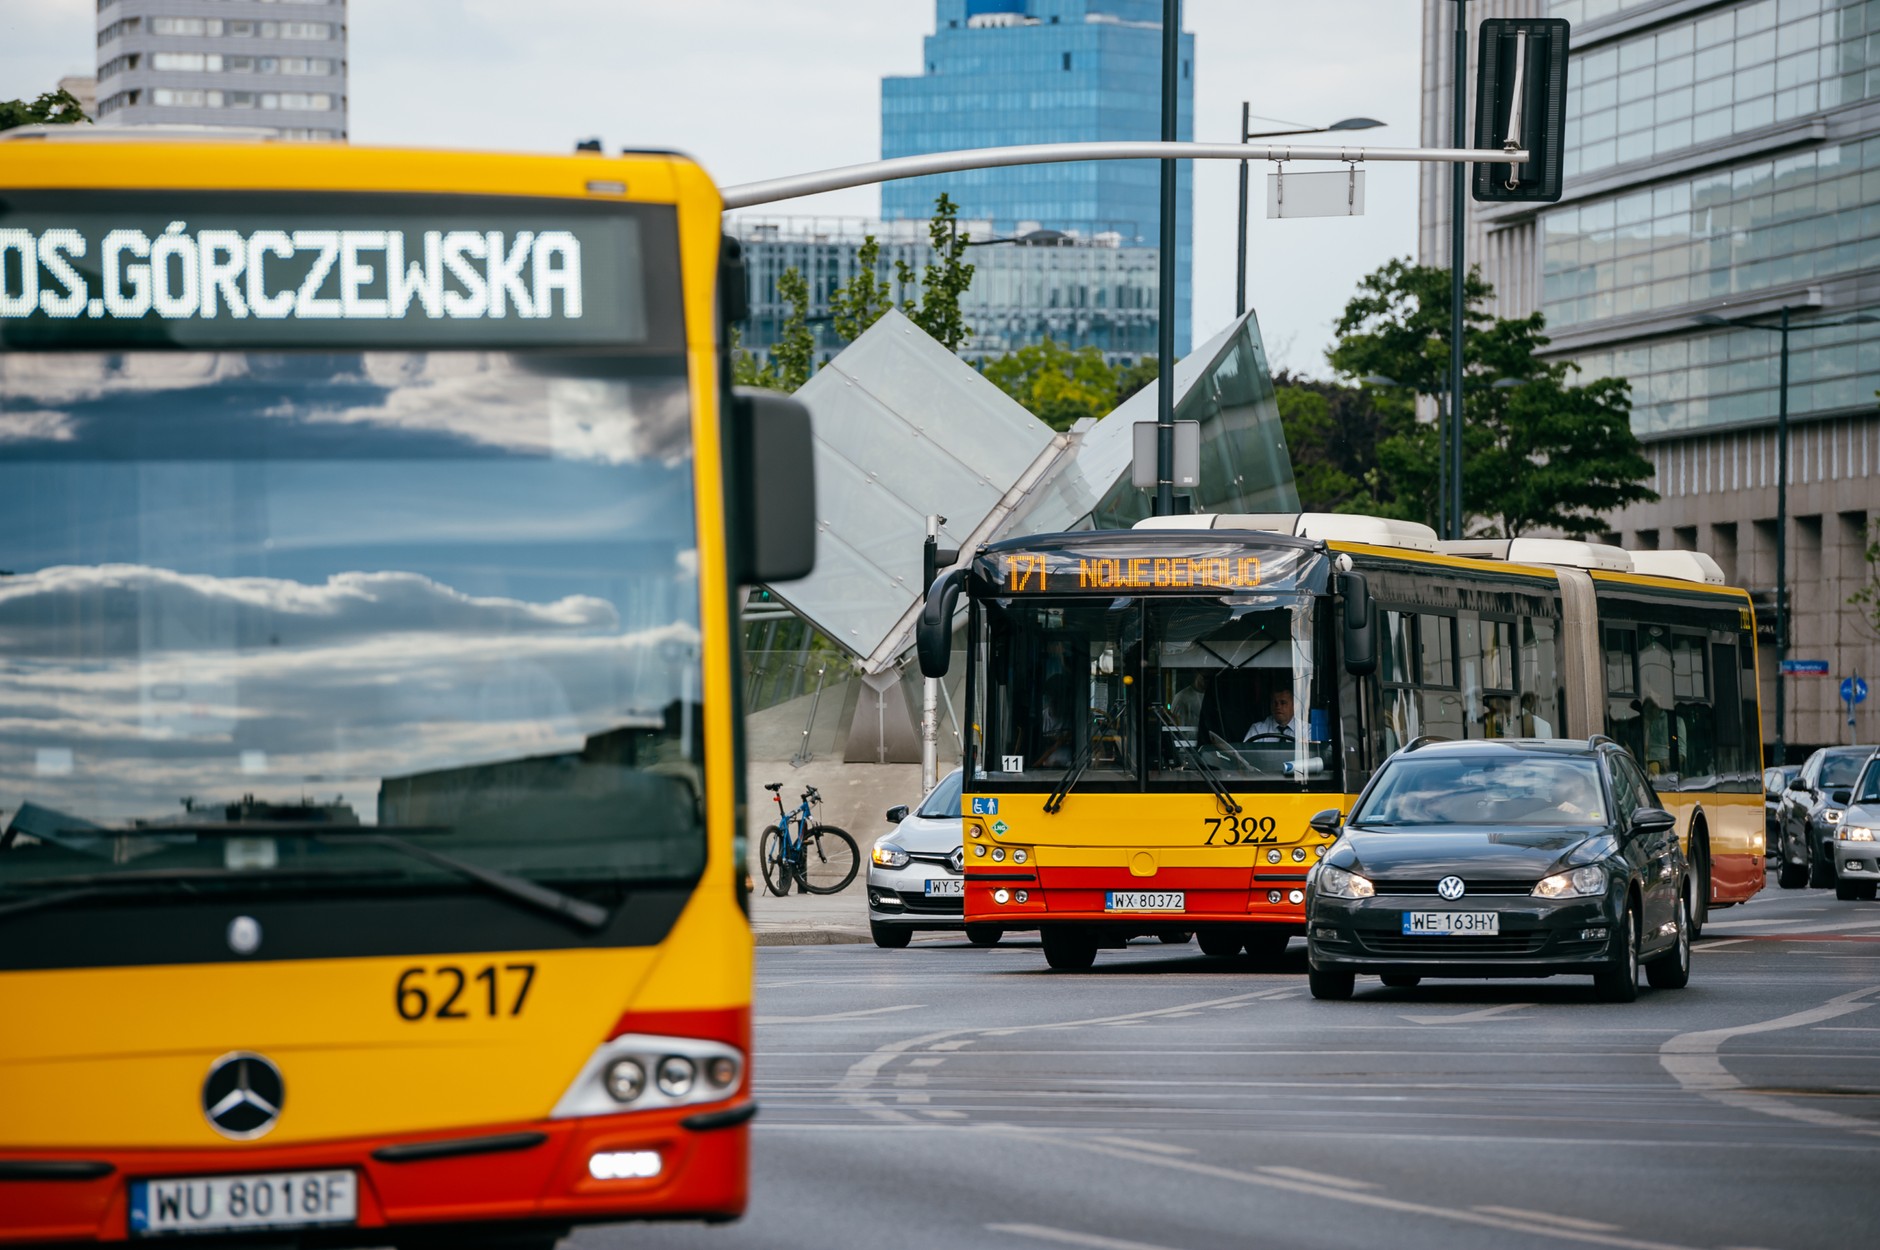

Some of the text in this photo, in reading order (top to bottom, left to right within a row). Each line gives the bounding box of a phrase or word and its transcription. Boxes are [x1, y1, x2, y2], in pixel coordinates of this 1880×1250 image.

[1006, 554, 1262, 592] 171 NOWE BEMOWO
[1004, 757, 1020, 771] 11
[1203, 815, 1278, 846] 7322
[932, 881, 949, 893] WY
[1115, 894, 1183, 908] WX 80372
[1413, 914, 1496, 930] WE 163HY
[393, 963, 538, 1022] 6217
[156, 1174, 348, 1222] WU 8018F
